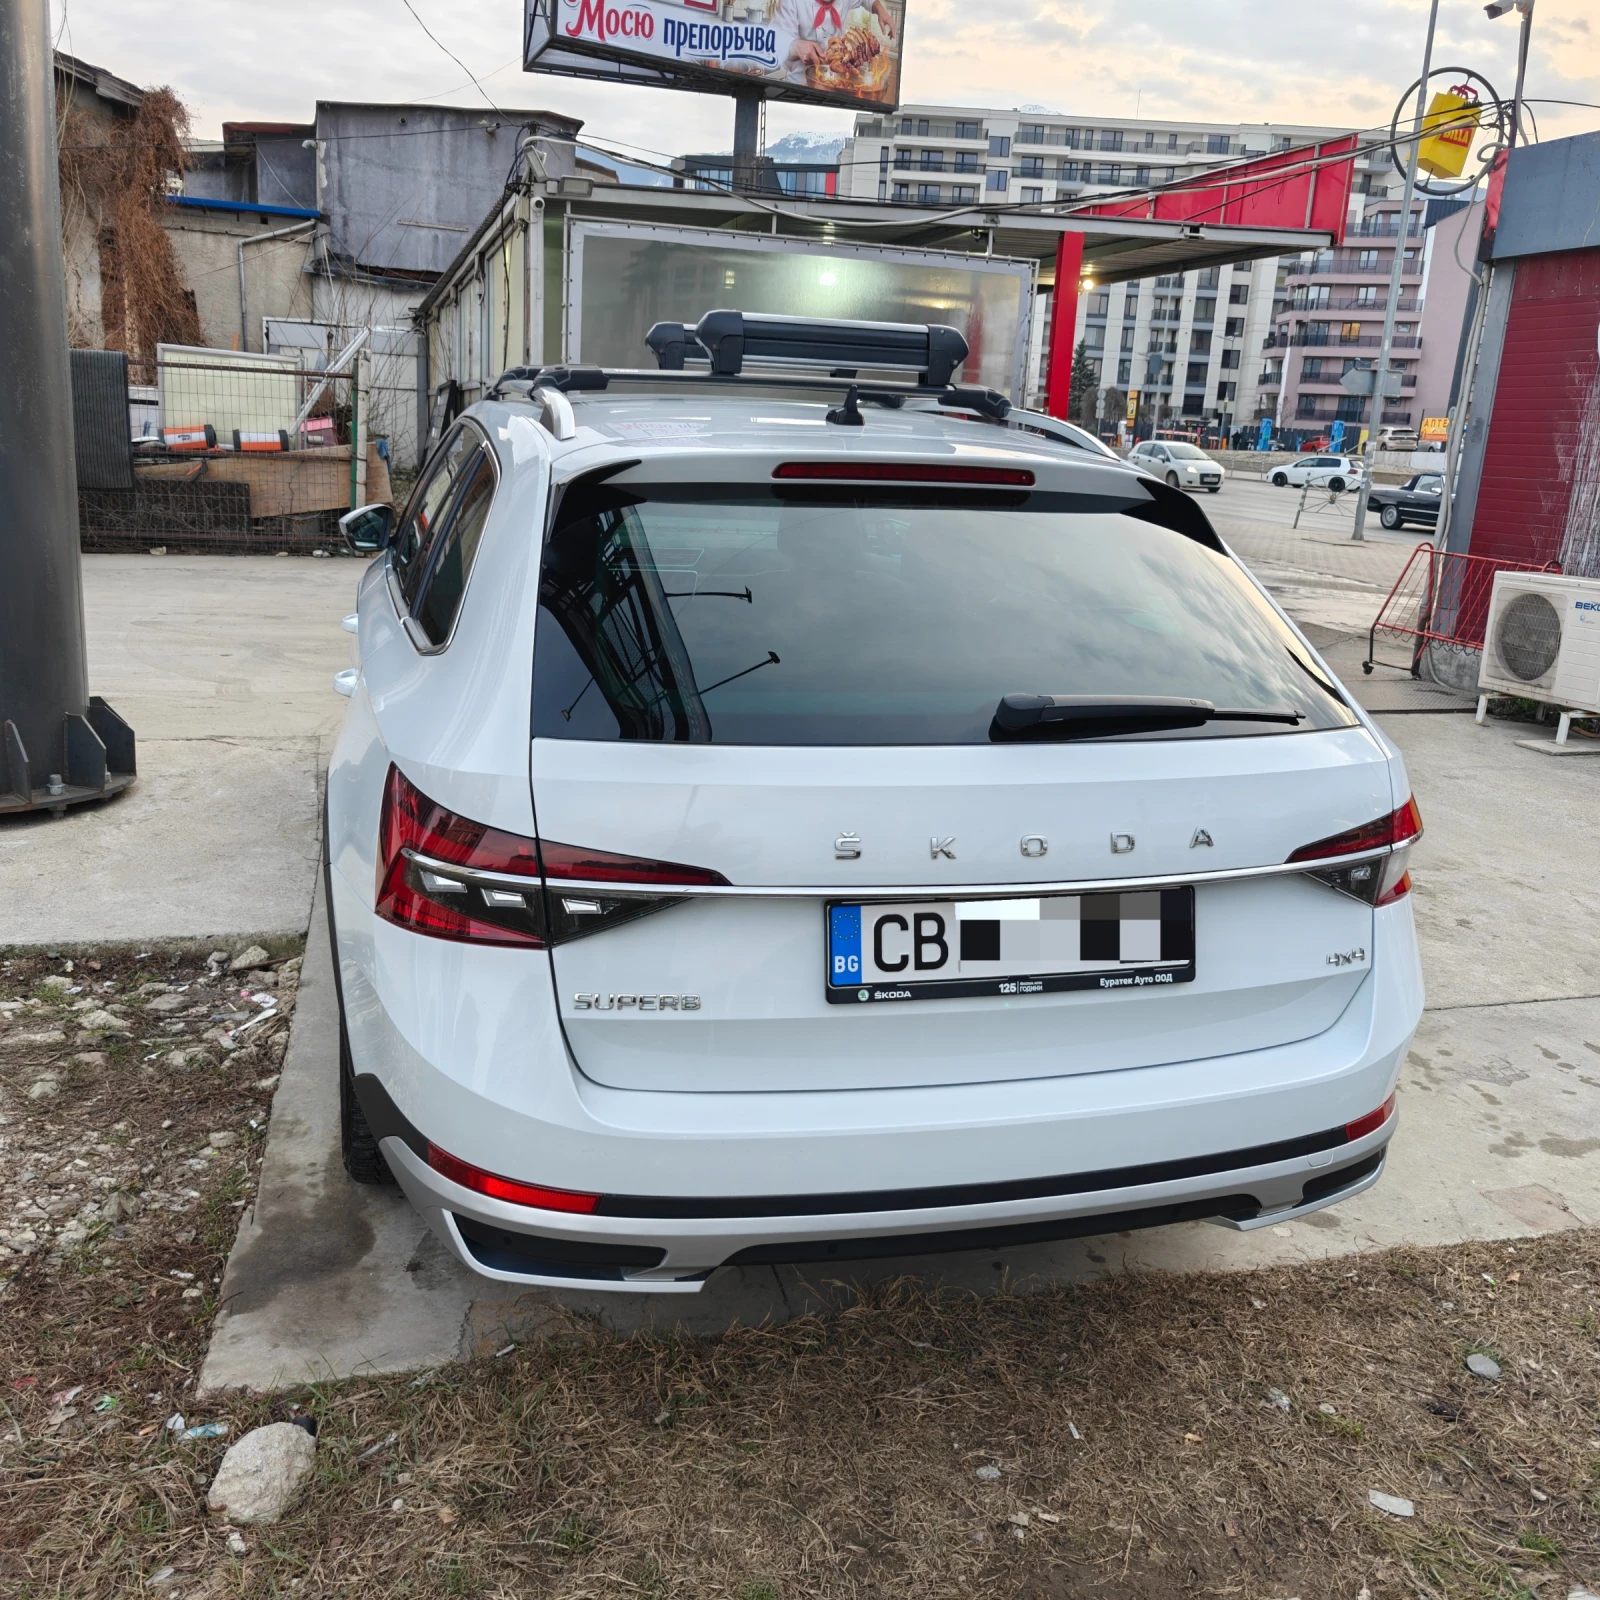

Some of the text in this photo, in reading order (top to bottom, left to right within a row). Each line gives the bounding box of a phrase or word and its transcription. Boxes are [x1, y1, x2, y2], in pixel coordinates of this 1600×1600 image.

[565, 0, 654, 42] Мосю
[1424, 419, 1448, 428] АПТЕ
[834, 955, 859, 973] BG
[998, 982, 1017, 993] 125
[1100, 973, 1173, 988] Еуратек Ауто ООД
[573, 992, 701, 1011] SUPERB
[874, 990, 912, 999] ŠKODA
